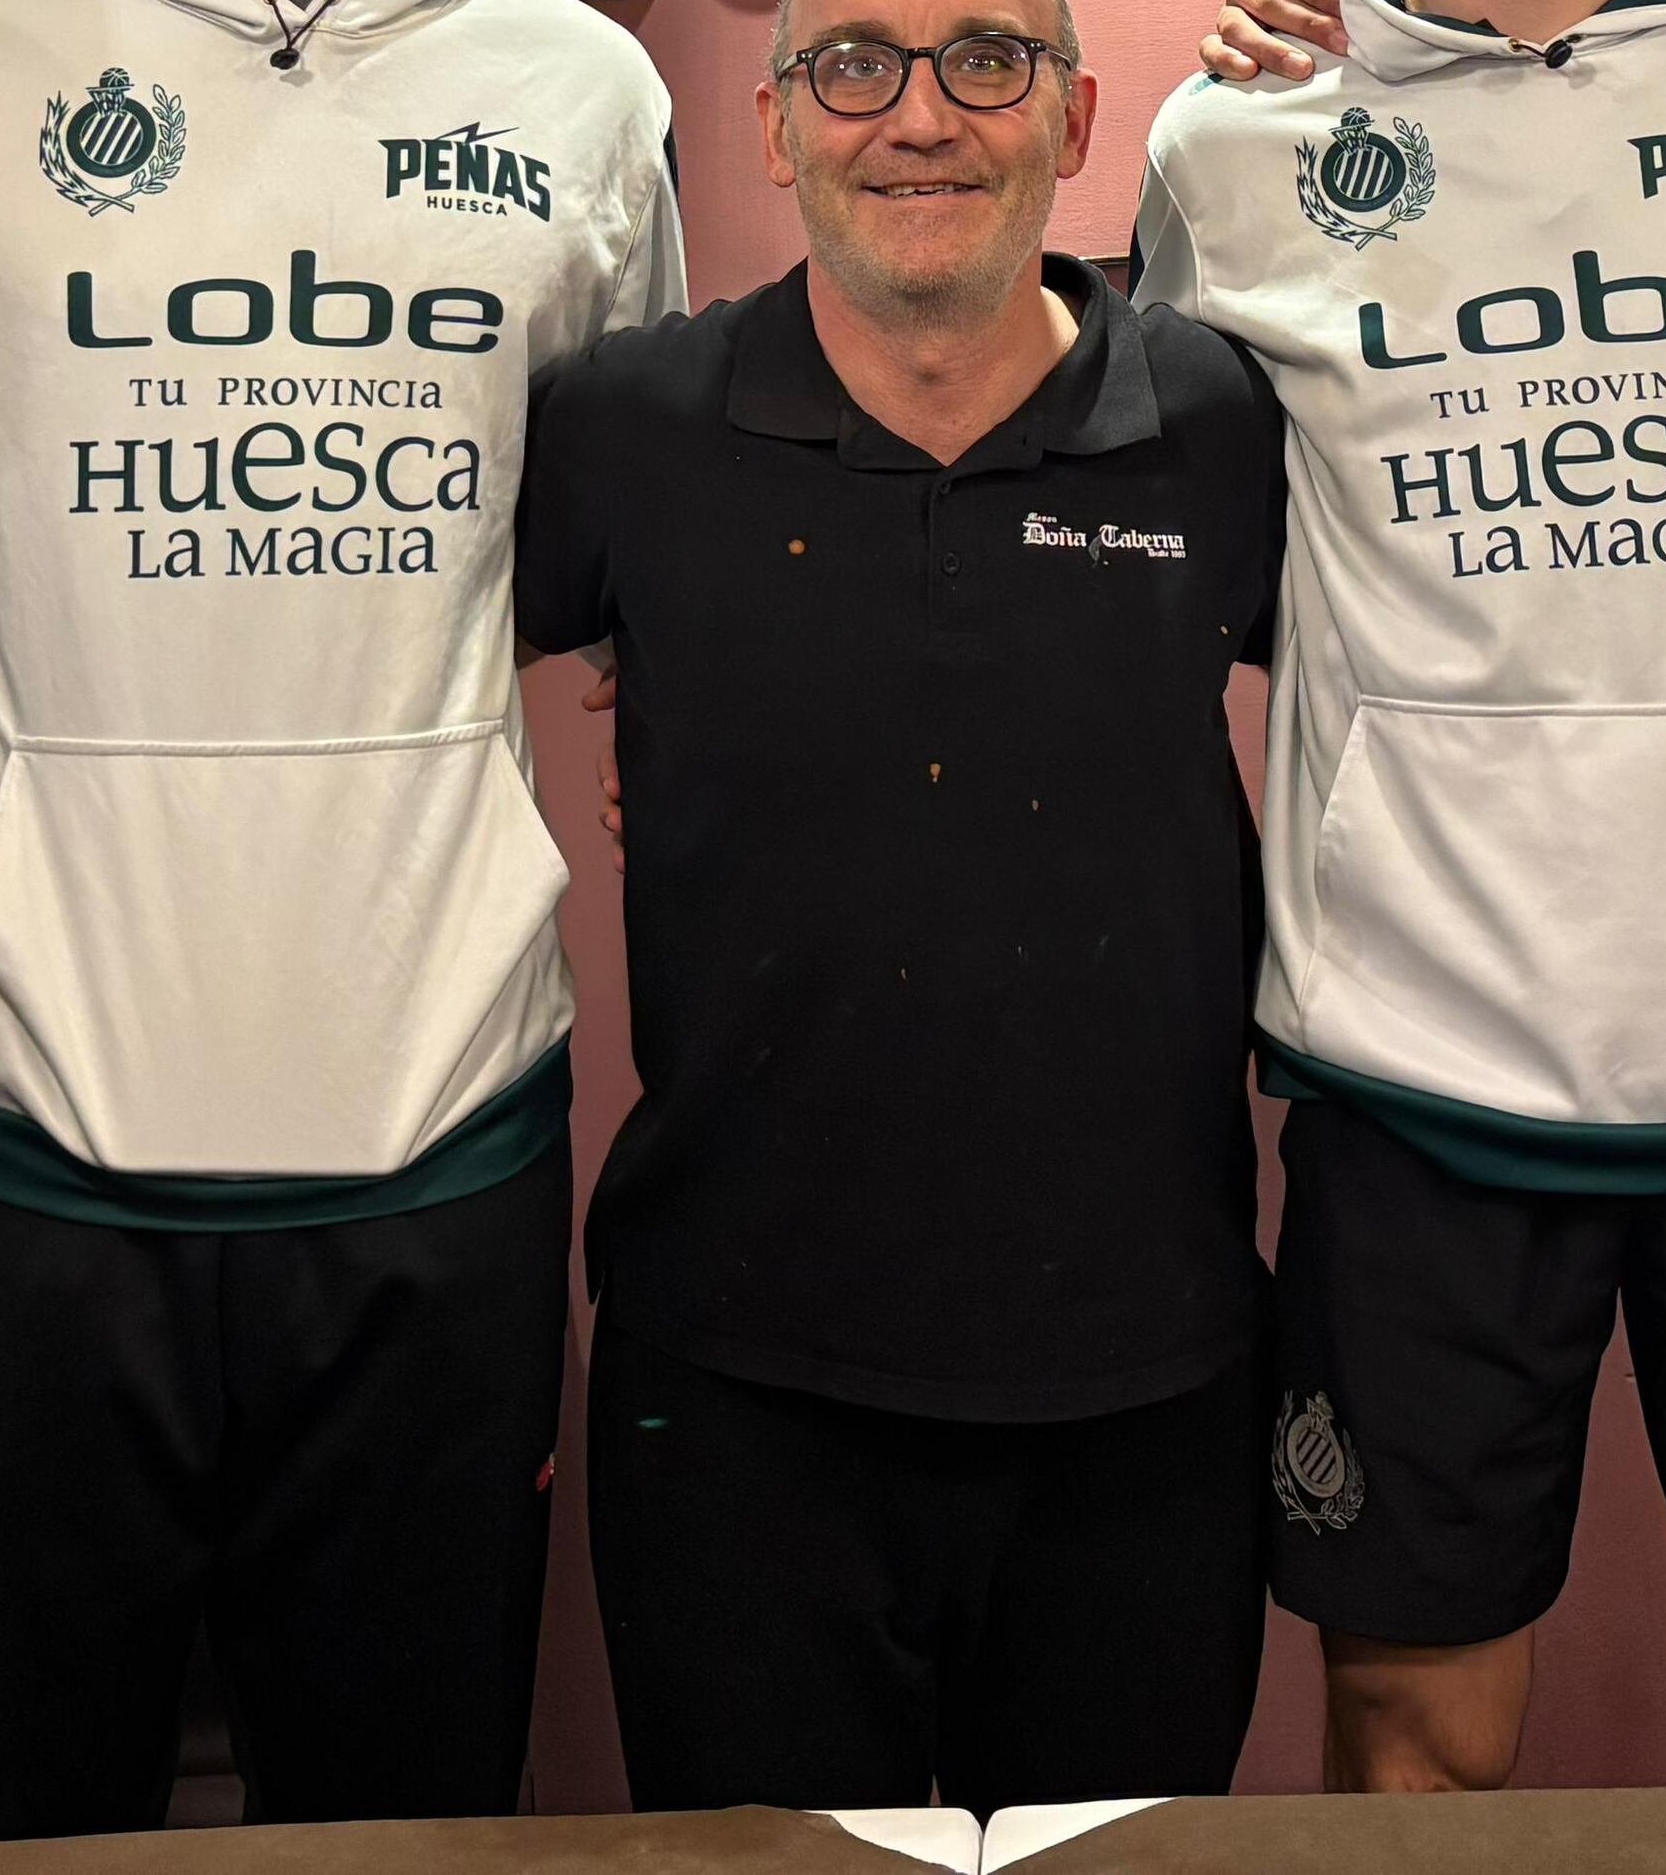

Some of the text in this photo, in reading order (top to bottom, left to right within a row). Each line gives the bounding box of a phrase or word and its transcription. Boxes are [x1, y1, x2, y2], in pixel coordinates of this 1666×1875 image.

[426, 195, 508, 216] HUESCA
[67, 249, 504, 354] Lobe
[129, 378, 187, 407] Tu
[1430, 386, 1489, 419] Tu
[1022, 522, 1185, 550] Doña Taberna
